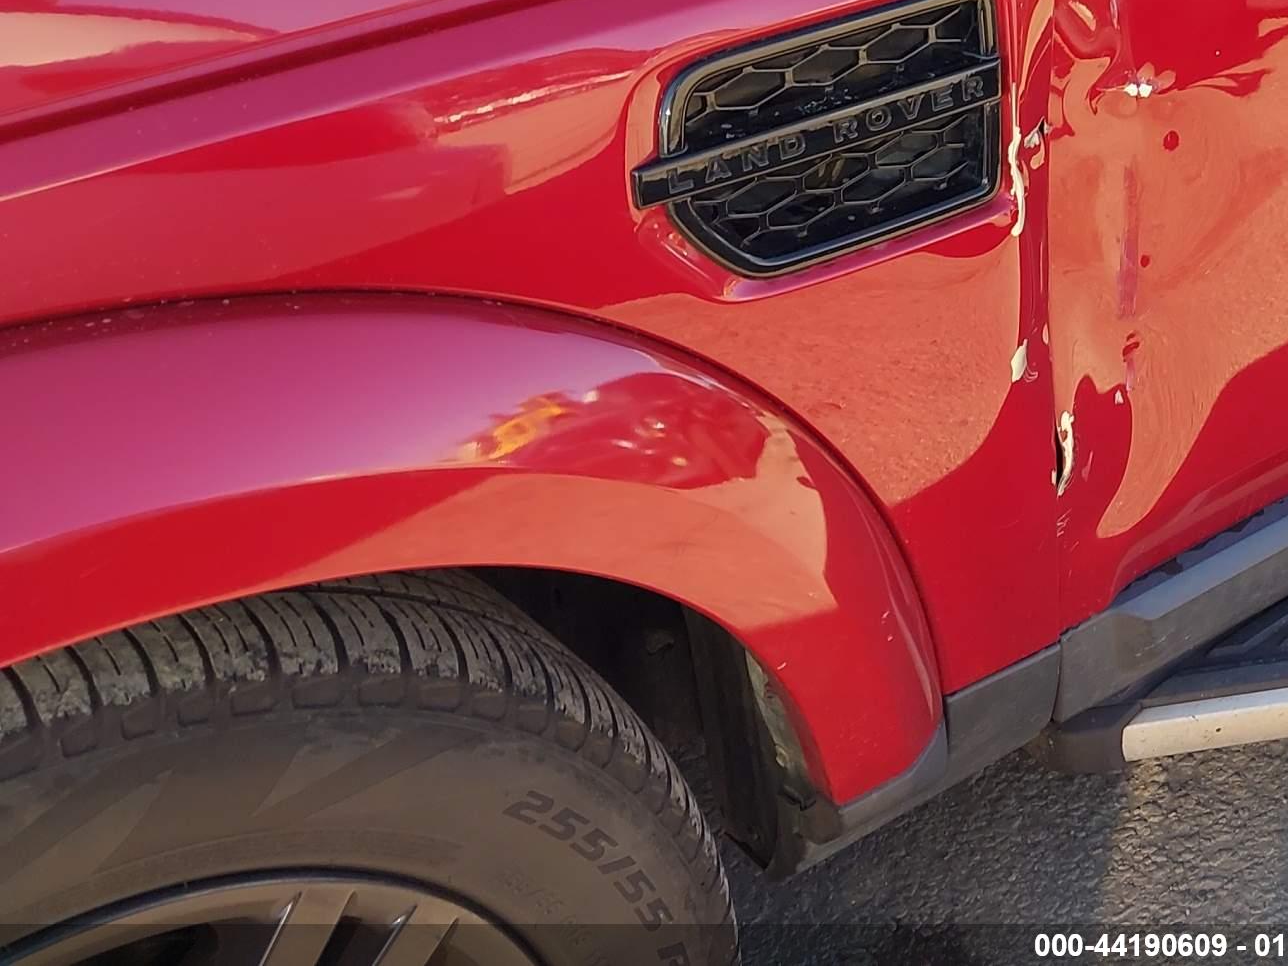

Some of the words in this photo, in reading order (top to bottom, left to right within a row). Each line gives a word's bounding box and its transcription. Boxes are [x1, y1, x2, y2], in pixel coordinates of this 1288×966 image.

[667, 133, 807, 194] LAND
[833, 74, 986, 143] ROVER
[503, 791, 674, 932] 255/55
